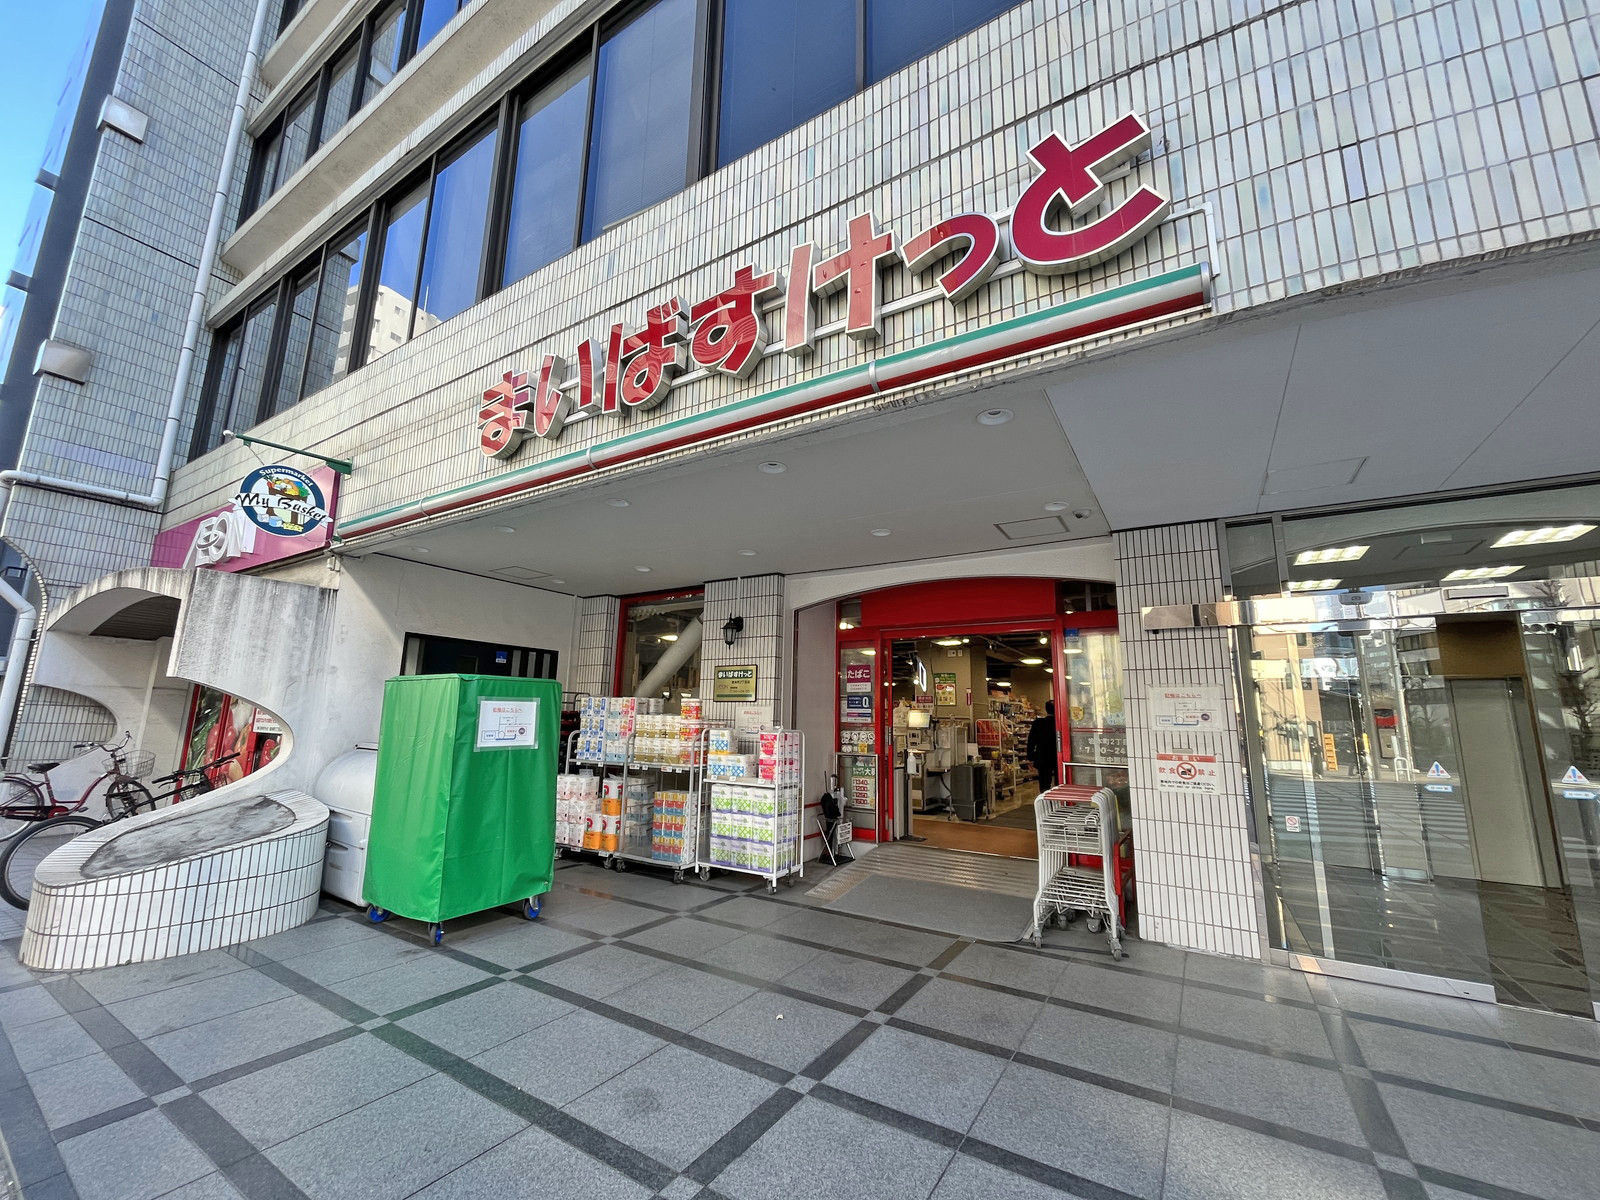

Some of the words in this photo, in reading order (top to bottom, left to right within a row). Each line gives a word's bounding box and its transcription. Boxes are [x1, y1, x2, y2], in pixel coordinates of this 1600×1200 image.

[478, 110, 1169, 459] まいばすけっと
[259, 467, 314, 487] Supermarket
[235, 493, 270, 508] My
[278, 497, 327, 521] Basket
[847, 669, 871, 679] たばこ
